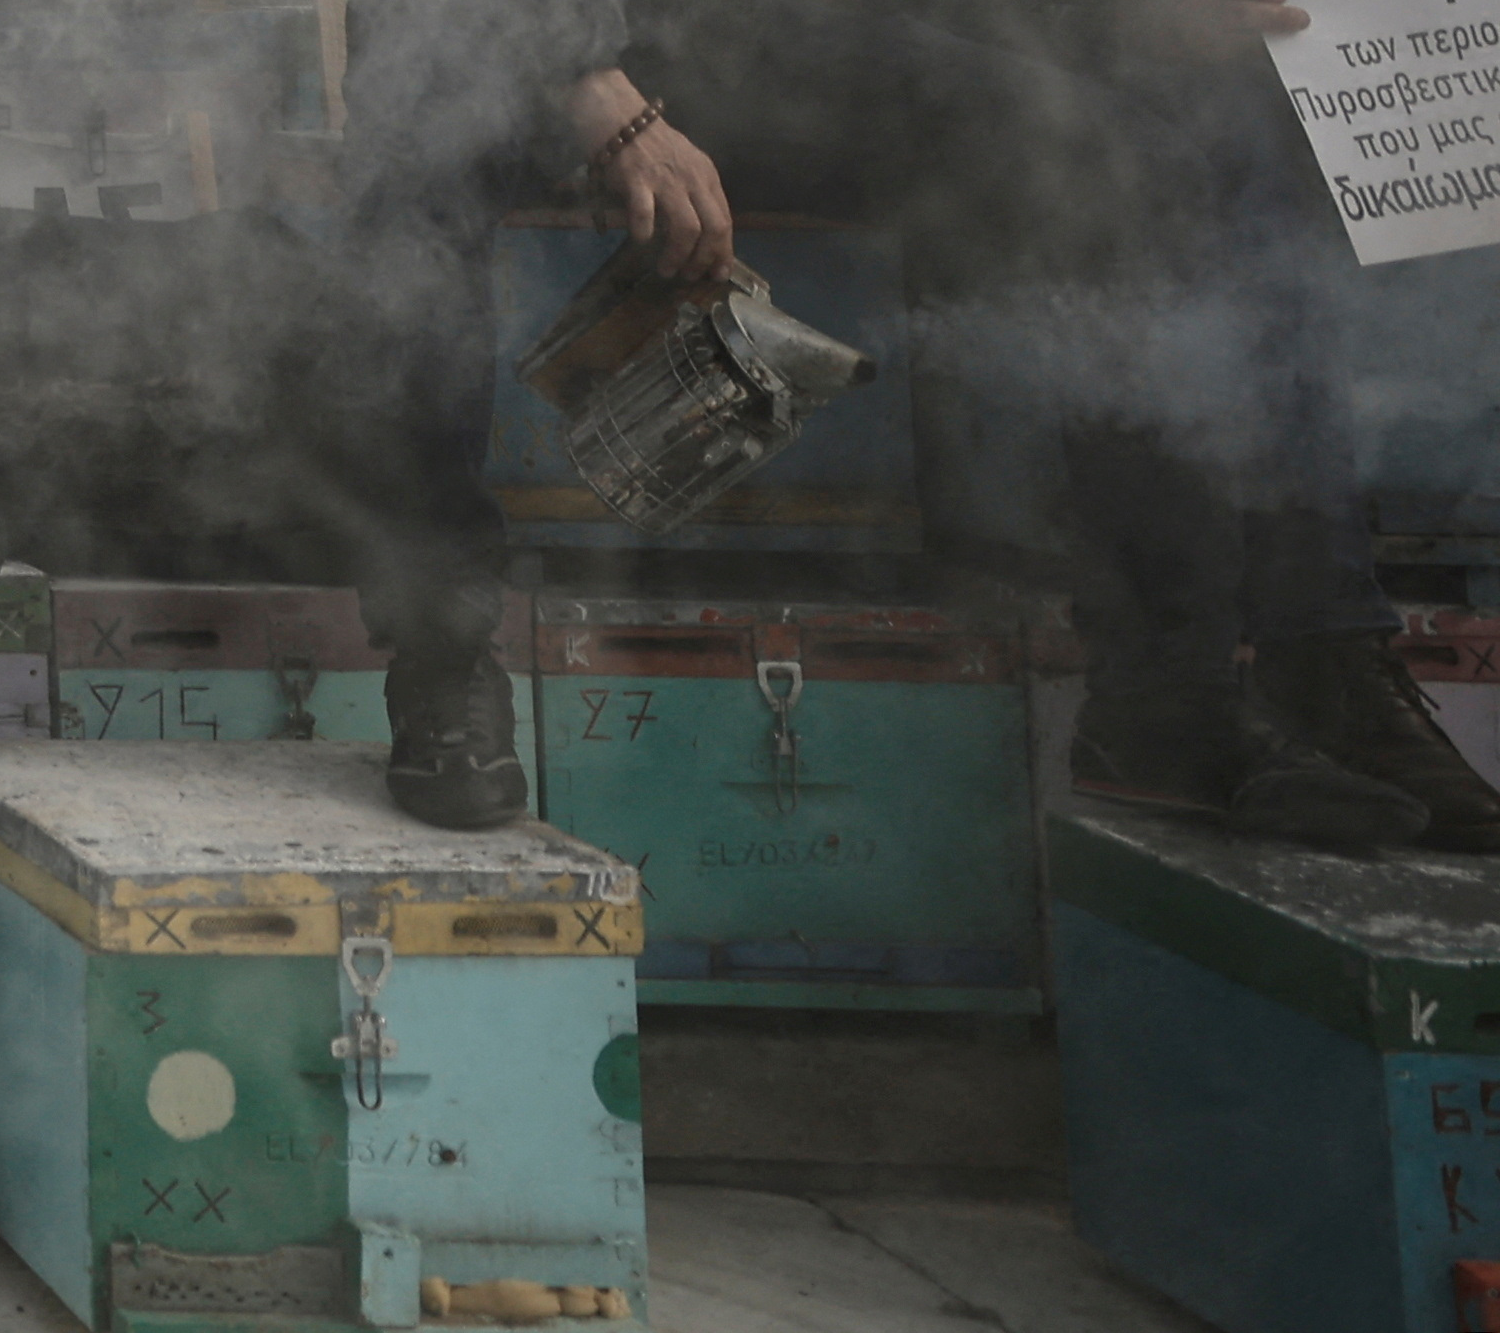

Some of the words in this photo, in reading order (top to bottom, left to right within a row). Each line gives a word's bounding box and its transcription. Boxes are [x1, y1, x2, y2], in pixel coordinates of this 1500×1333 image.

[1335, 35, 1396, 69] των
[1406, 21, 1500, 61] περιο
[1290, 71, 1500, 125] Πυροσβεστικ
[1353, 126, 1420, 161] που
[1428, 115, 1494, 153] μας
